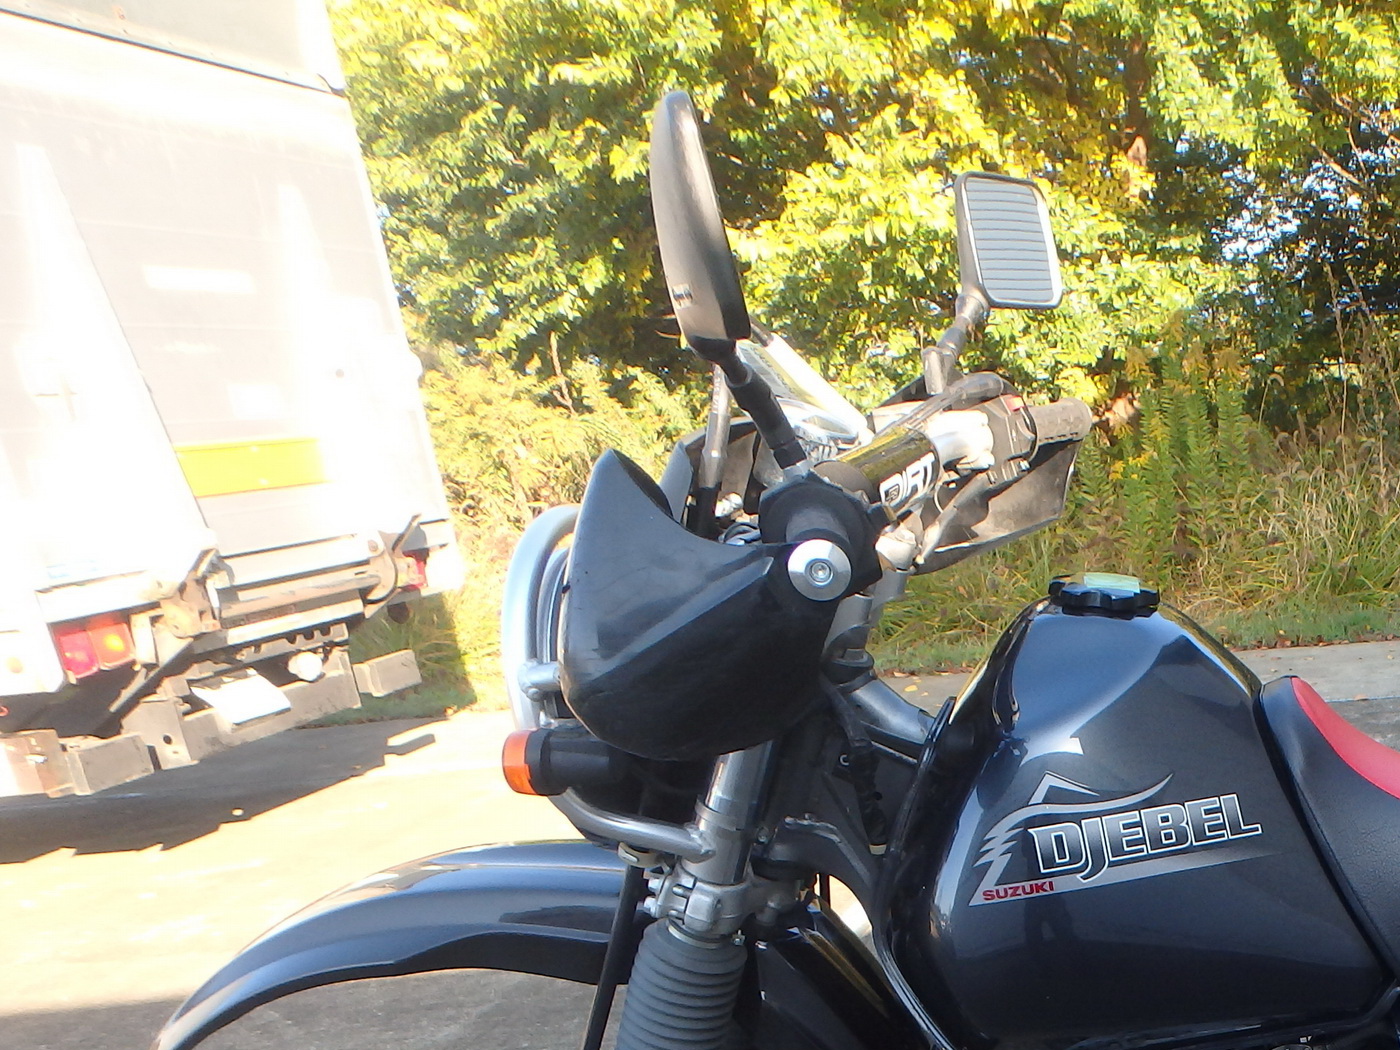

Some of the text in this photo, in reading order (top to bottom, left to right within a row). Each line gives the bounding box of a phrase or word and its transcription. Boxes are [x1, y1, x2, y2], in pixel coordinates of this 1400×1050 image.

[879, 451, 936, 508] DIRT
[1028, 793, 1264, 883] DJEBEL
[981, 880, 1056, 902] SUZUKI
